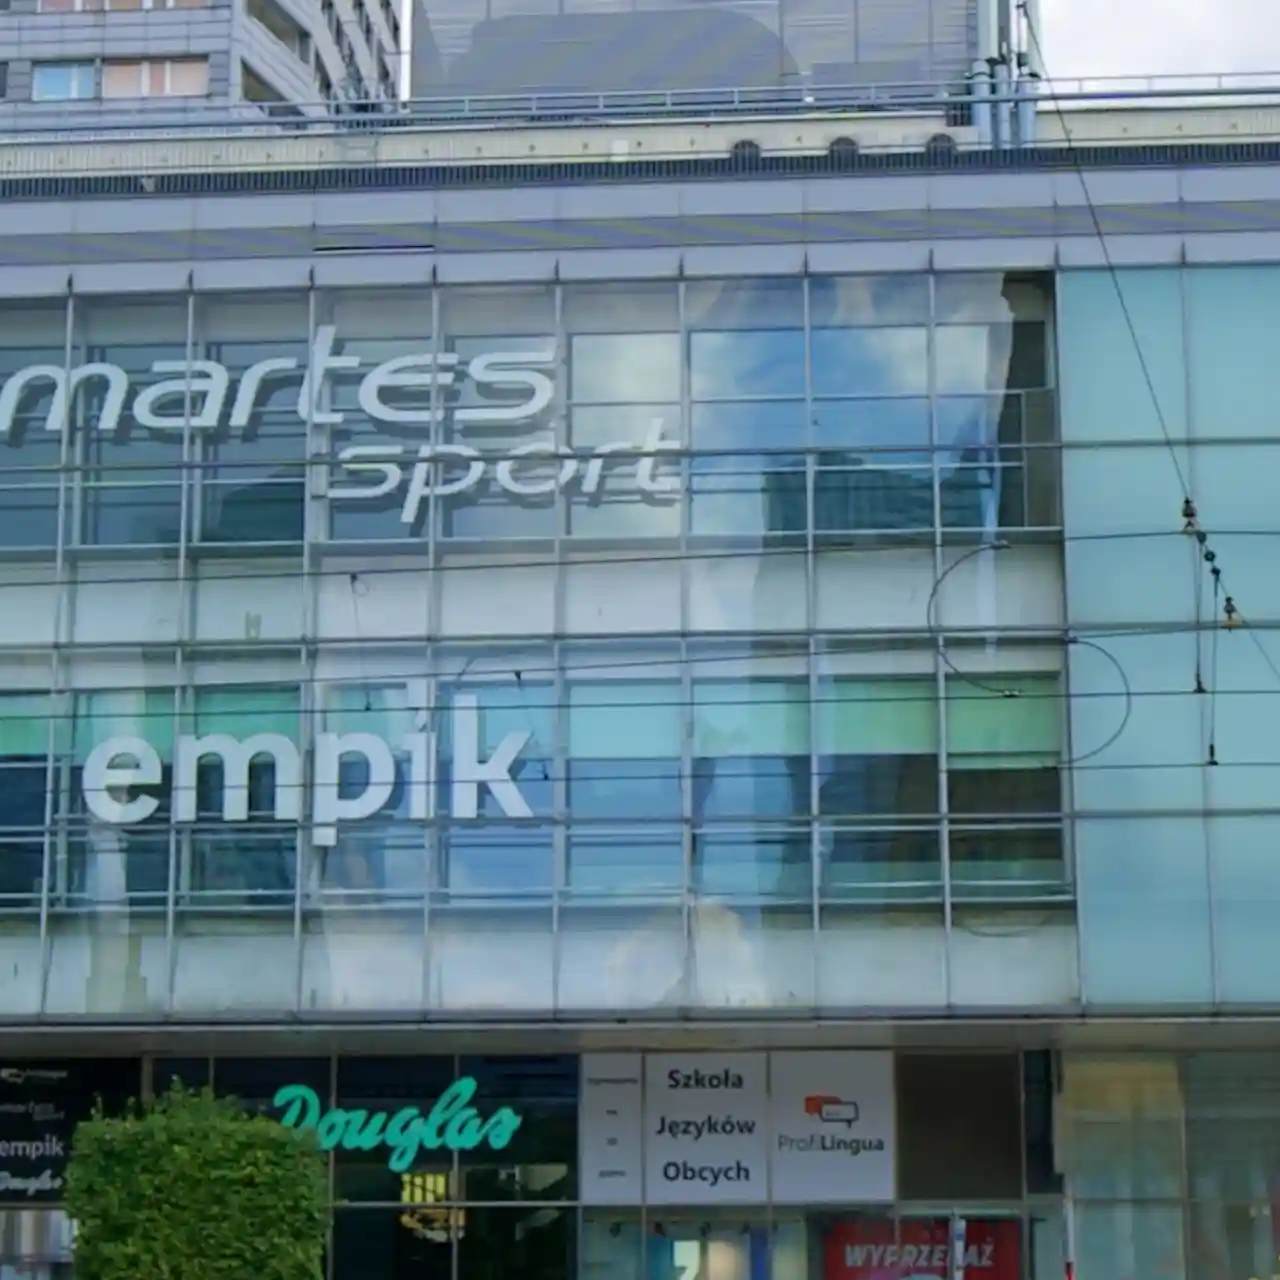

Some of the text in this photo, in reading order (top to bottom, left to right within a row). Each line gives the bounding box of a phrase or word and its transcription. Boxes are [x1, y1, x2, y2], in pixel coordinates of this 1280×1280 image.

[324, 416, 688, 524] sport
[82, 682, 534, 846] empik
[668, 1069, 744, 1090] Szkoła
[272, 1076, 522, 1173] Douglas
[655, 1115, 757, 1141] Języków
[662, 1160, 751, 1187] Obcych
[844, 1236, 996, 1268] WYPRZEAŻ
